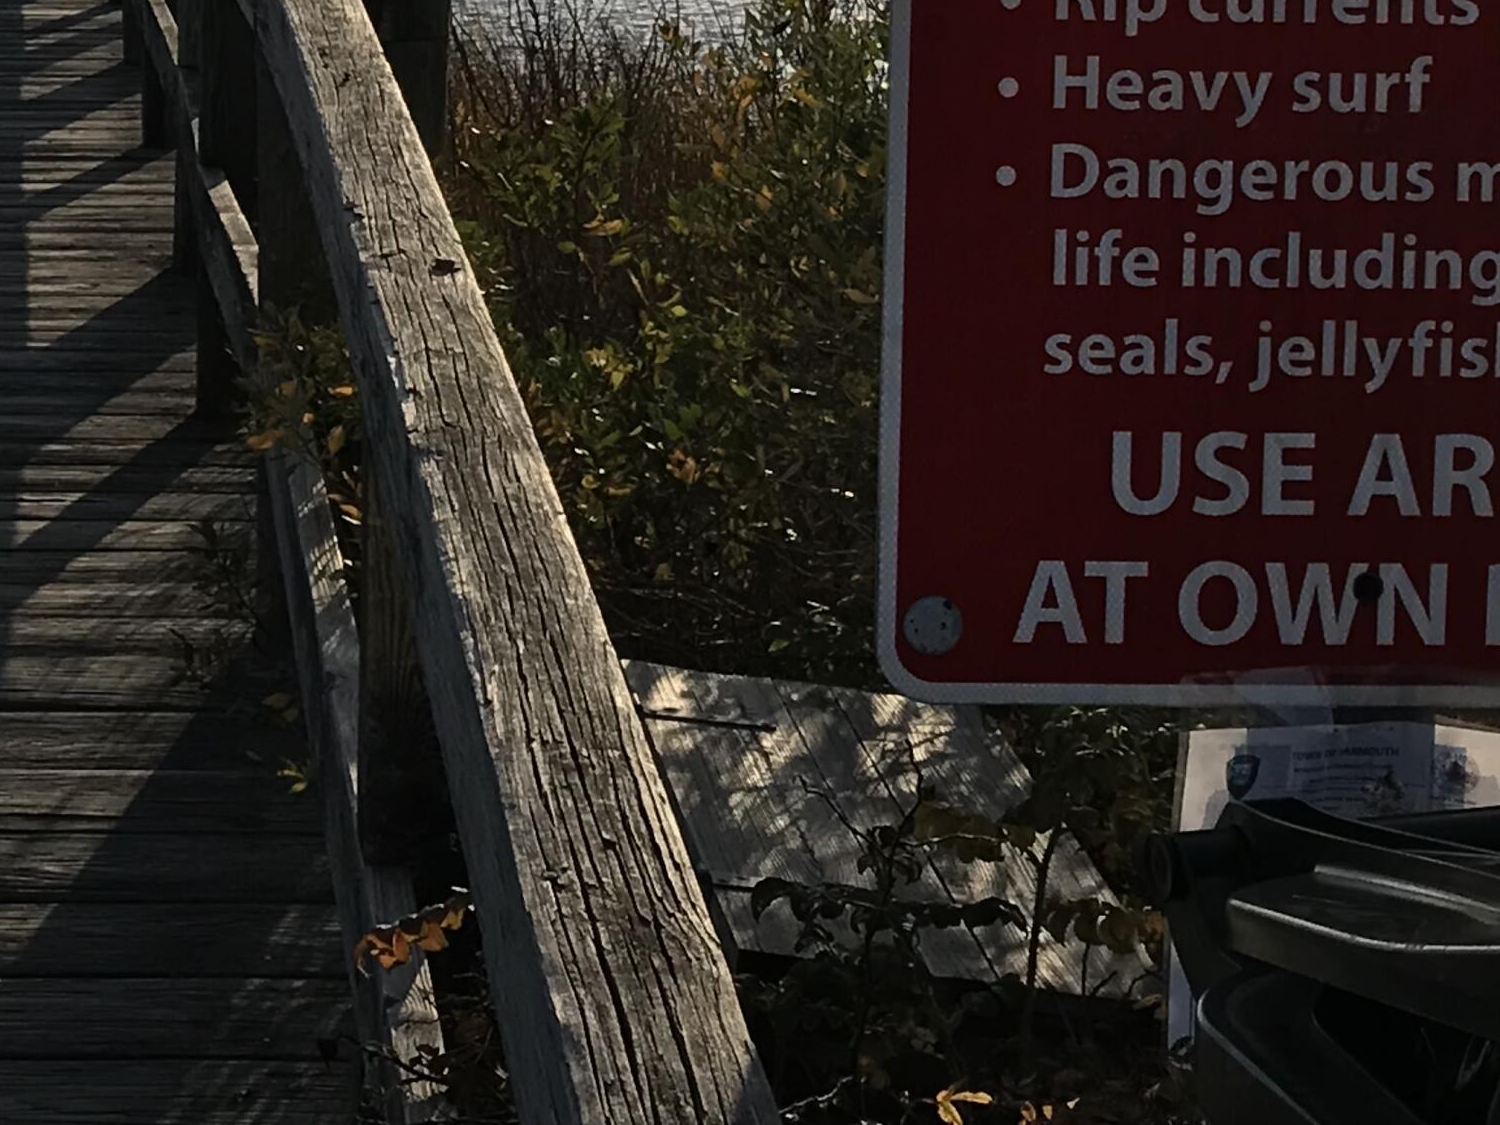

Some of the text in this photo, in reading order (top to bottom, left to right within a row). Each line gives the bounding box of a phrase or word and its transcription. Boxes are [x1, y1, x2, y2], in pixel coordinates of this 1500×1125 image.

[1054, 55, 1432, 127] Heavy surf
[1051, 143, 1434, 215] Dangerous
[1054, 229, 1500, 305] life including
[1044, 319, 1500, 393] seals, jellyfis
[1112, 431, 1494, 516] USE AR
[1013, 561, 1148, 643] AT
[1178, 561, 1448, 645] OWN
